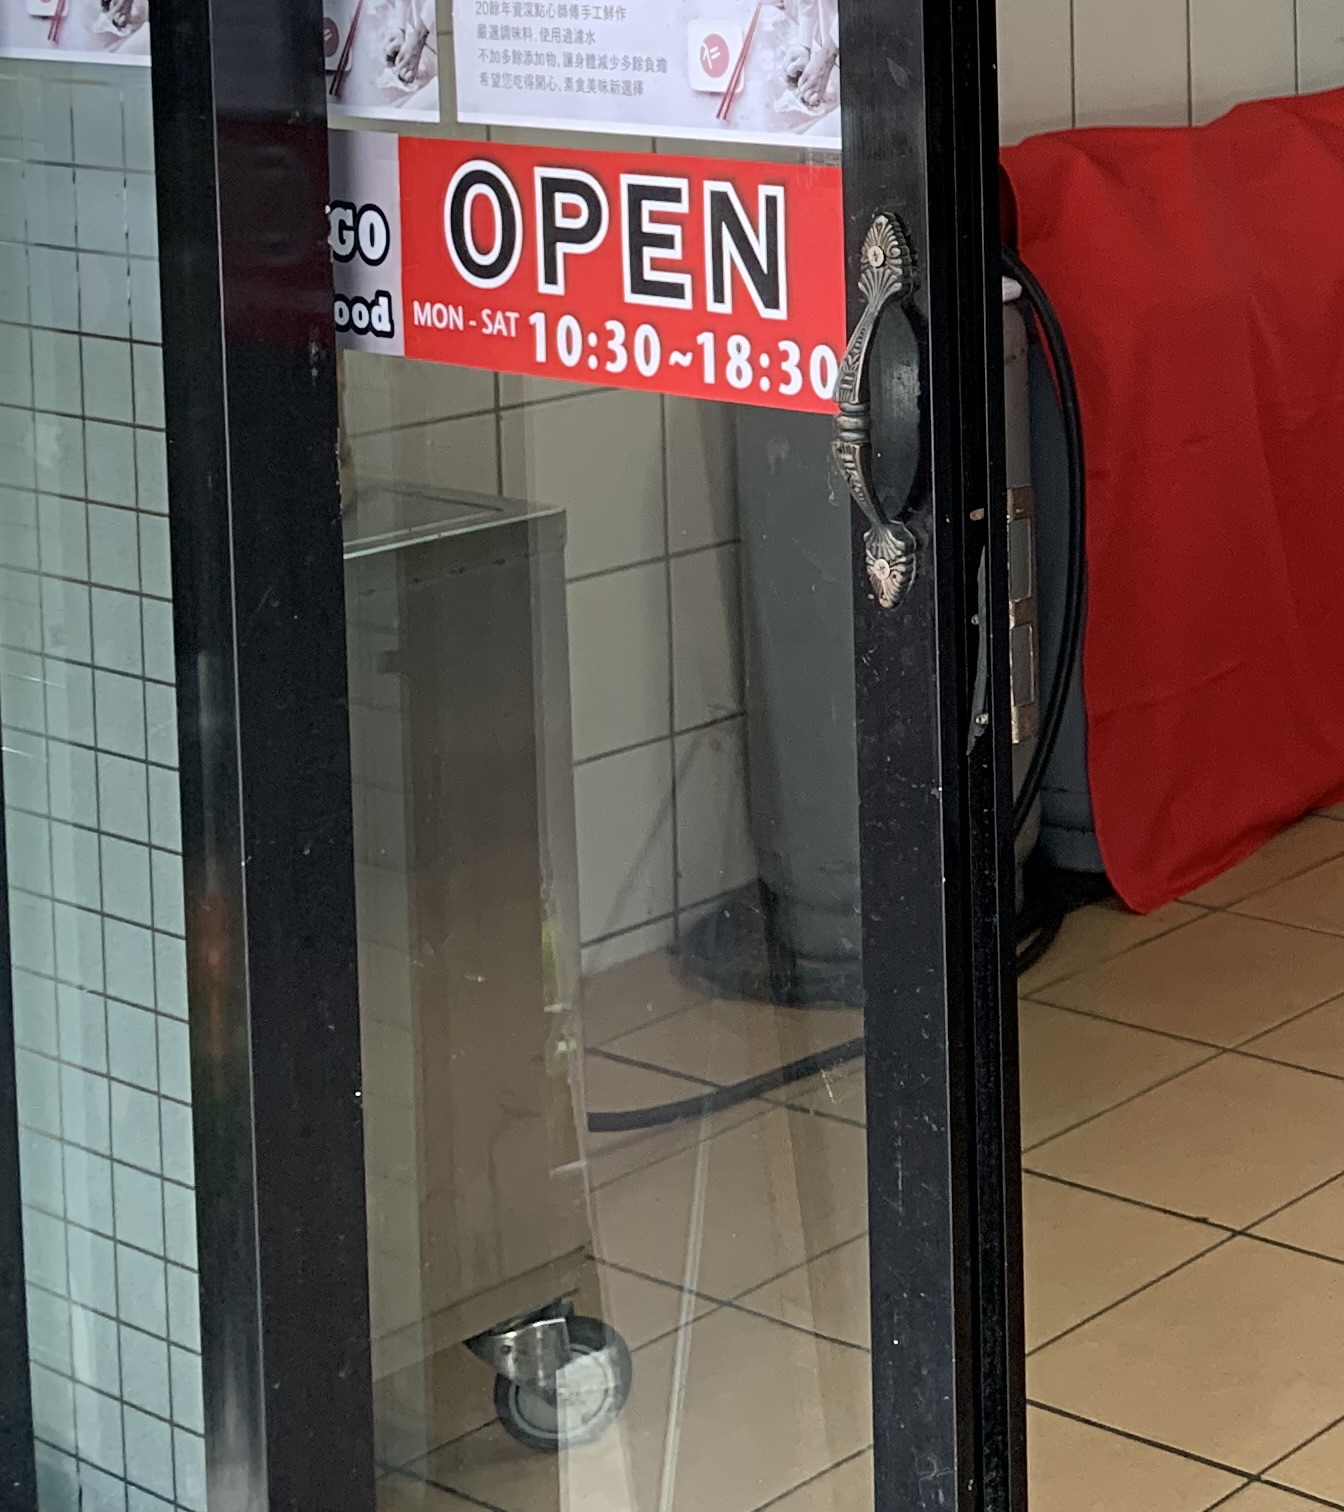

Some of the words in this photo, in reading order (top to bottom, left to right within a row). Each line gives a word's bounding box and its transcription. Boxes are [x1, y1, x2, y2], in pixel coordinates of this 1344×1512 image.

[443, 159, 788, 321] OPEN
[334, 289, 395, 339] ood
[413, 301, 468, 330] MON
[482, 311, 519, 338] SAT
[529, 312, 838, 400] 10:30~18:30
